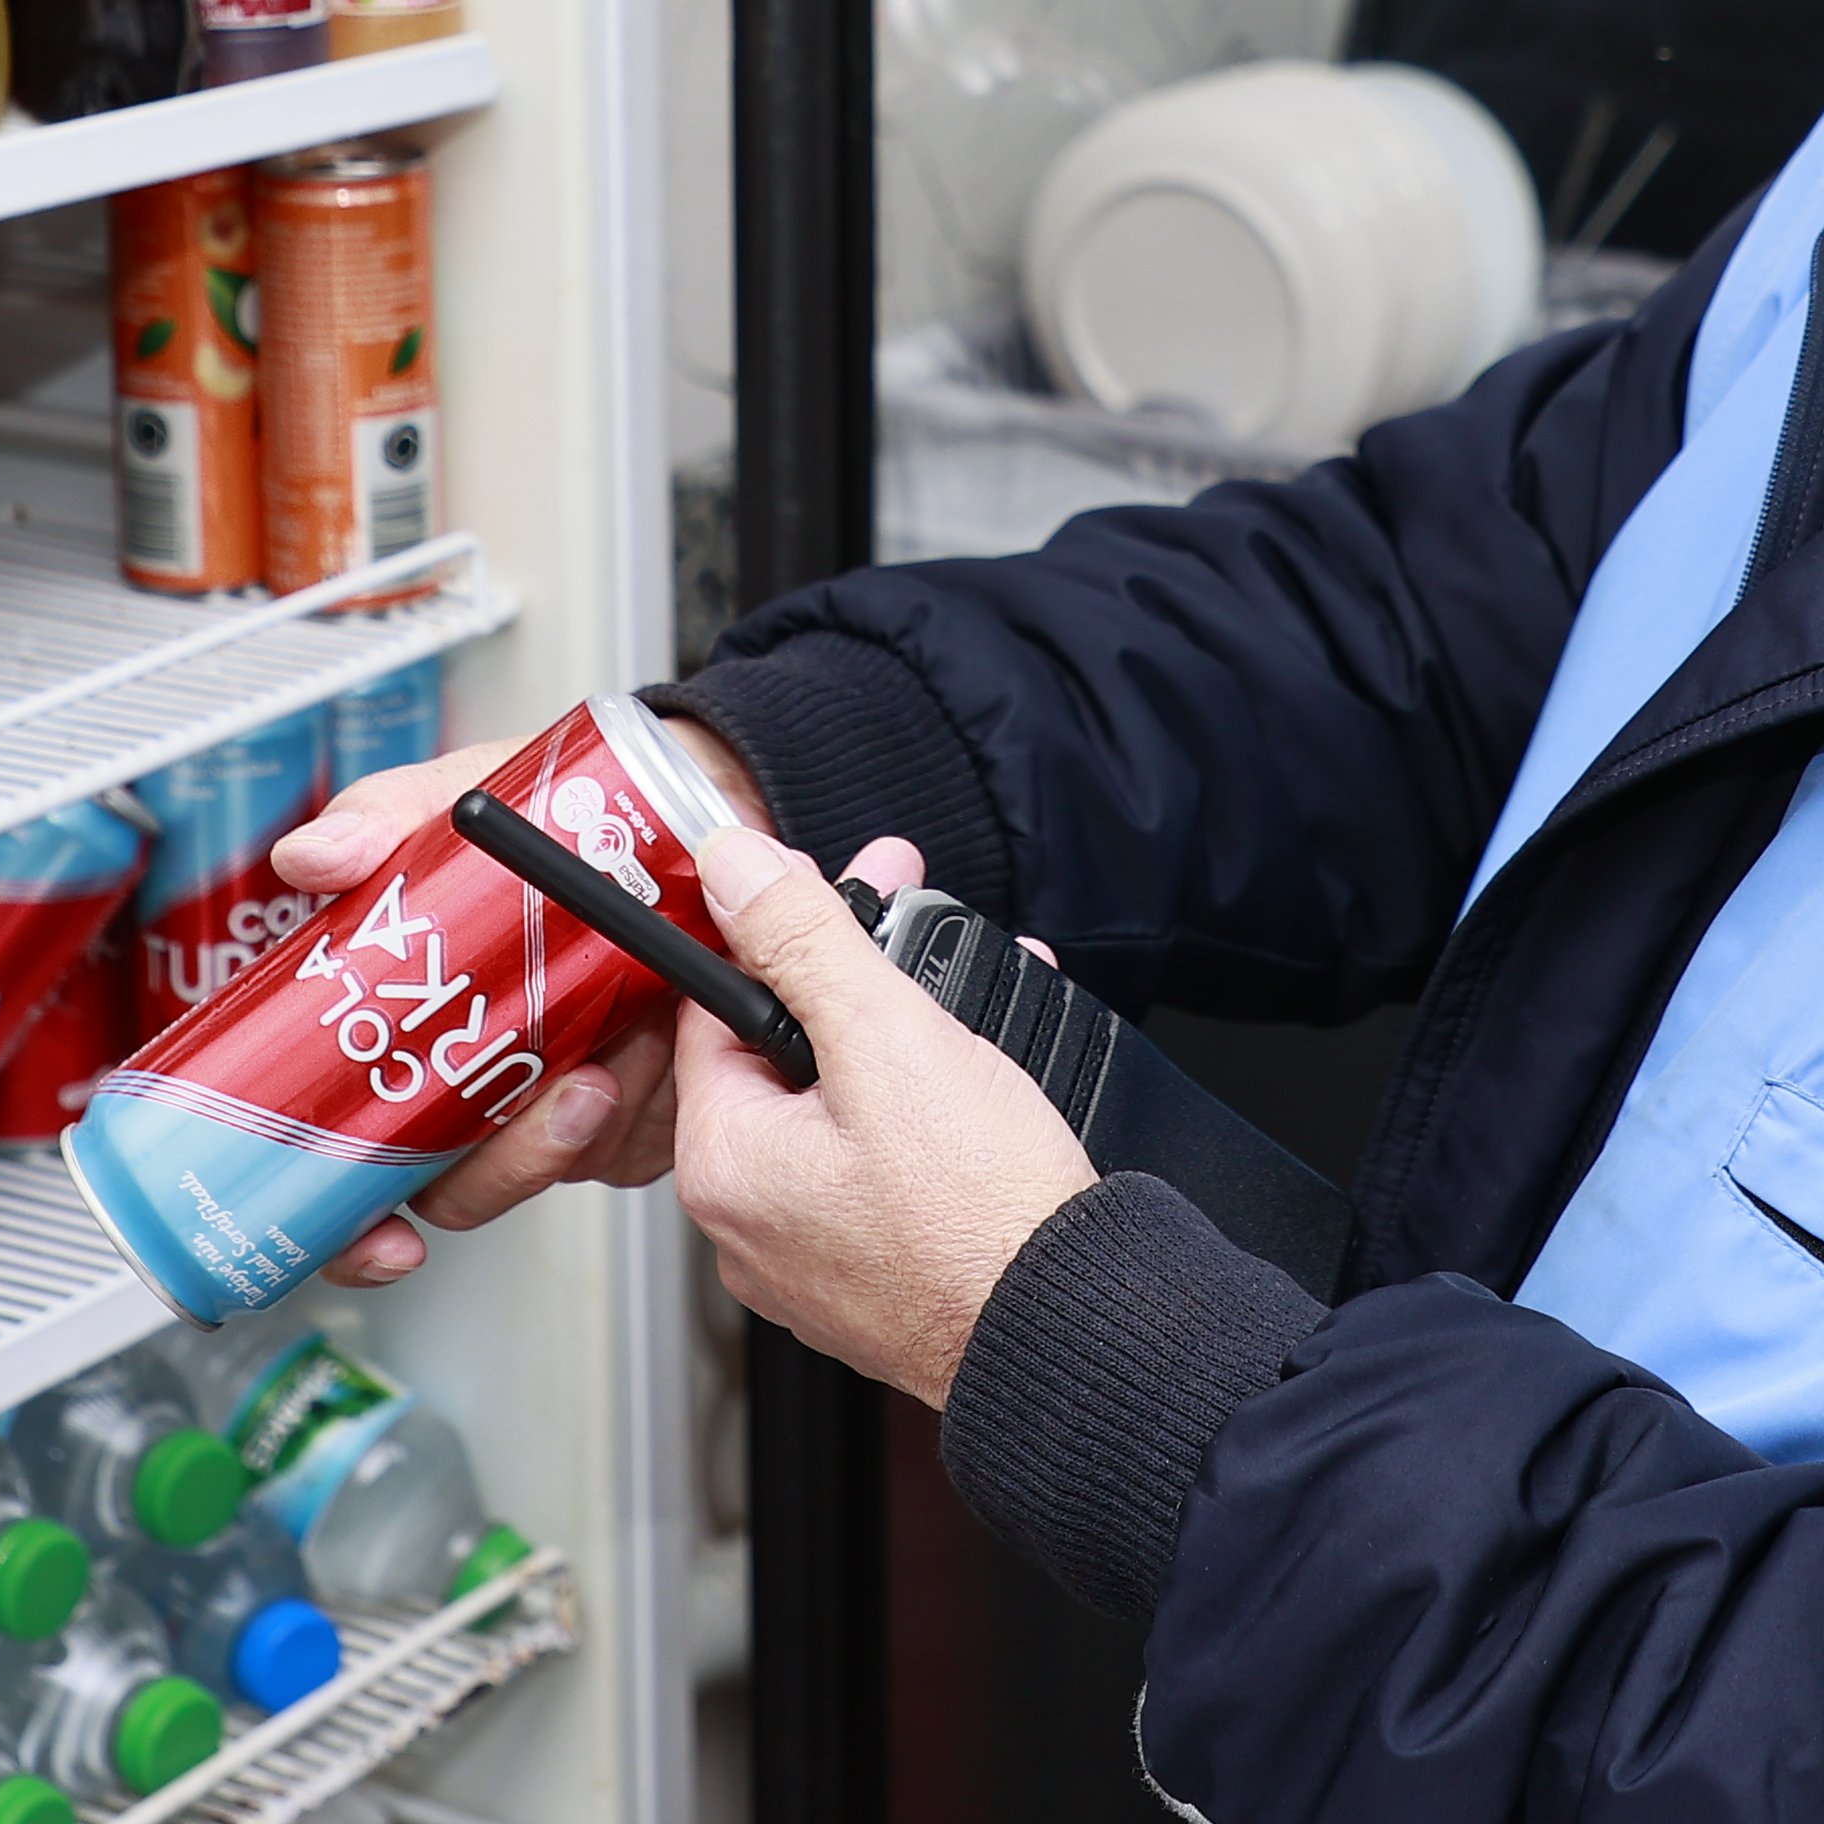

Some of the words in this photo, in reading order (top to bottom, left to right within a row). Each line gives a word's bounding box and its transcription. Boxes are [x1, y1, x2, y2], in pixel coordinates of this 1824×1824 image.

[295, 933, 426, 1103] COLA
[179, 1169, 256, 1258] Sertifikalı
[266, 1224, 311, 1268] Kolası
[244, 1252, 291, 1287] Helal
